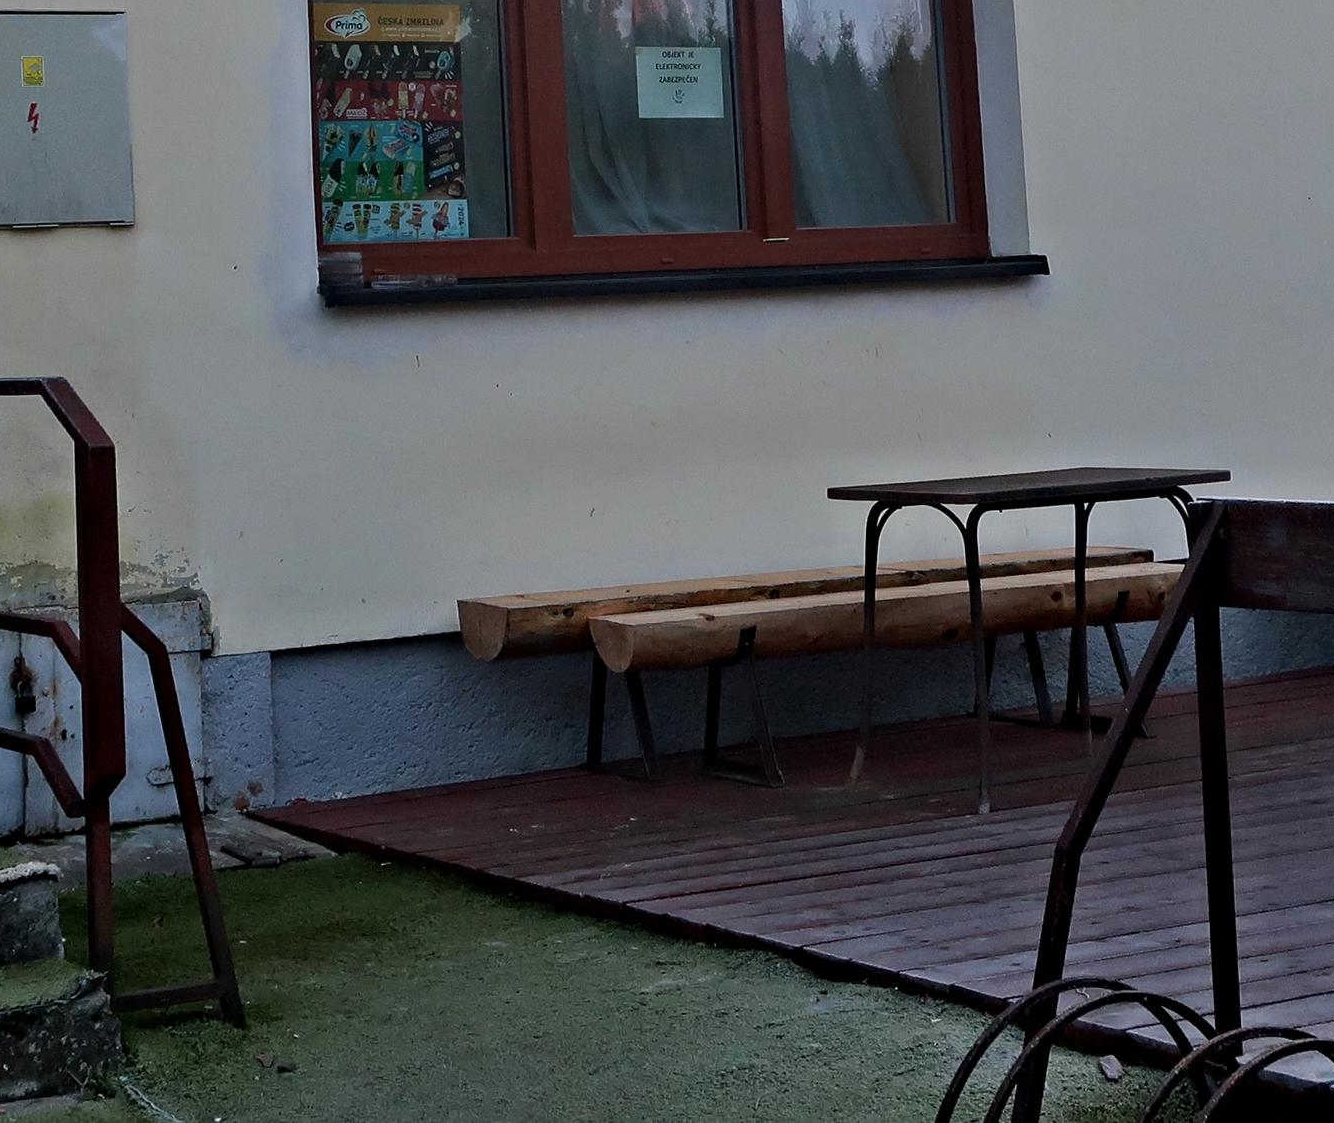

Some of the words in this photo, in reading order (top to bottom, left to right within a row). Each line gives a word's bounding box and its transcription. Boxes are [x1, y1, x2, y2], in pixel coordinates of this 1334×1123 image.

[335, 20, 363, 30] Prima
[662, 50, 685, 58] OBJEKT
[687, 50, 694, 58] JE
[655, 62, 701, 70] ELEKTRONICKY
[658, 74, 699, 84] ZABEZPEČEN
